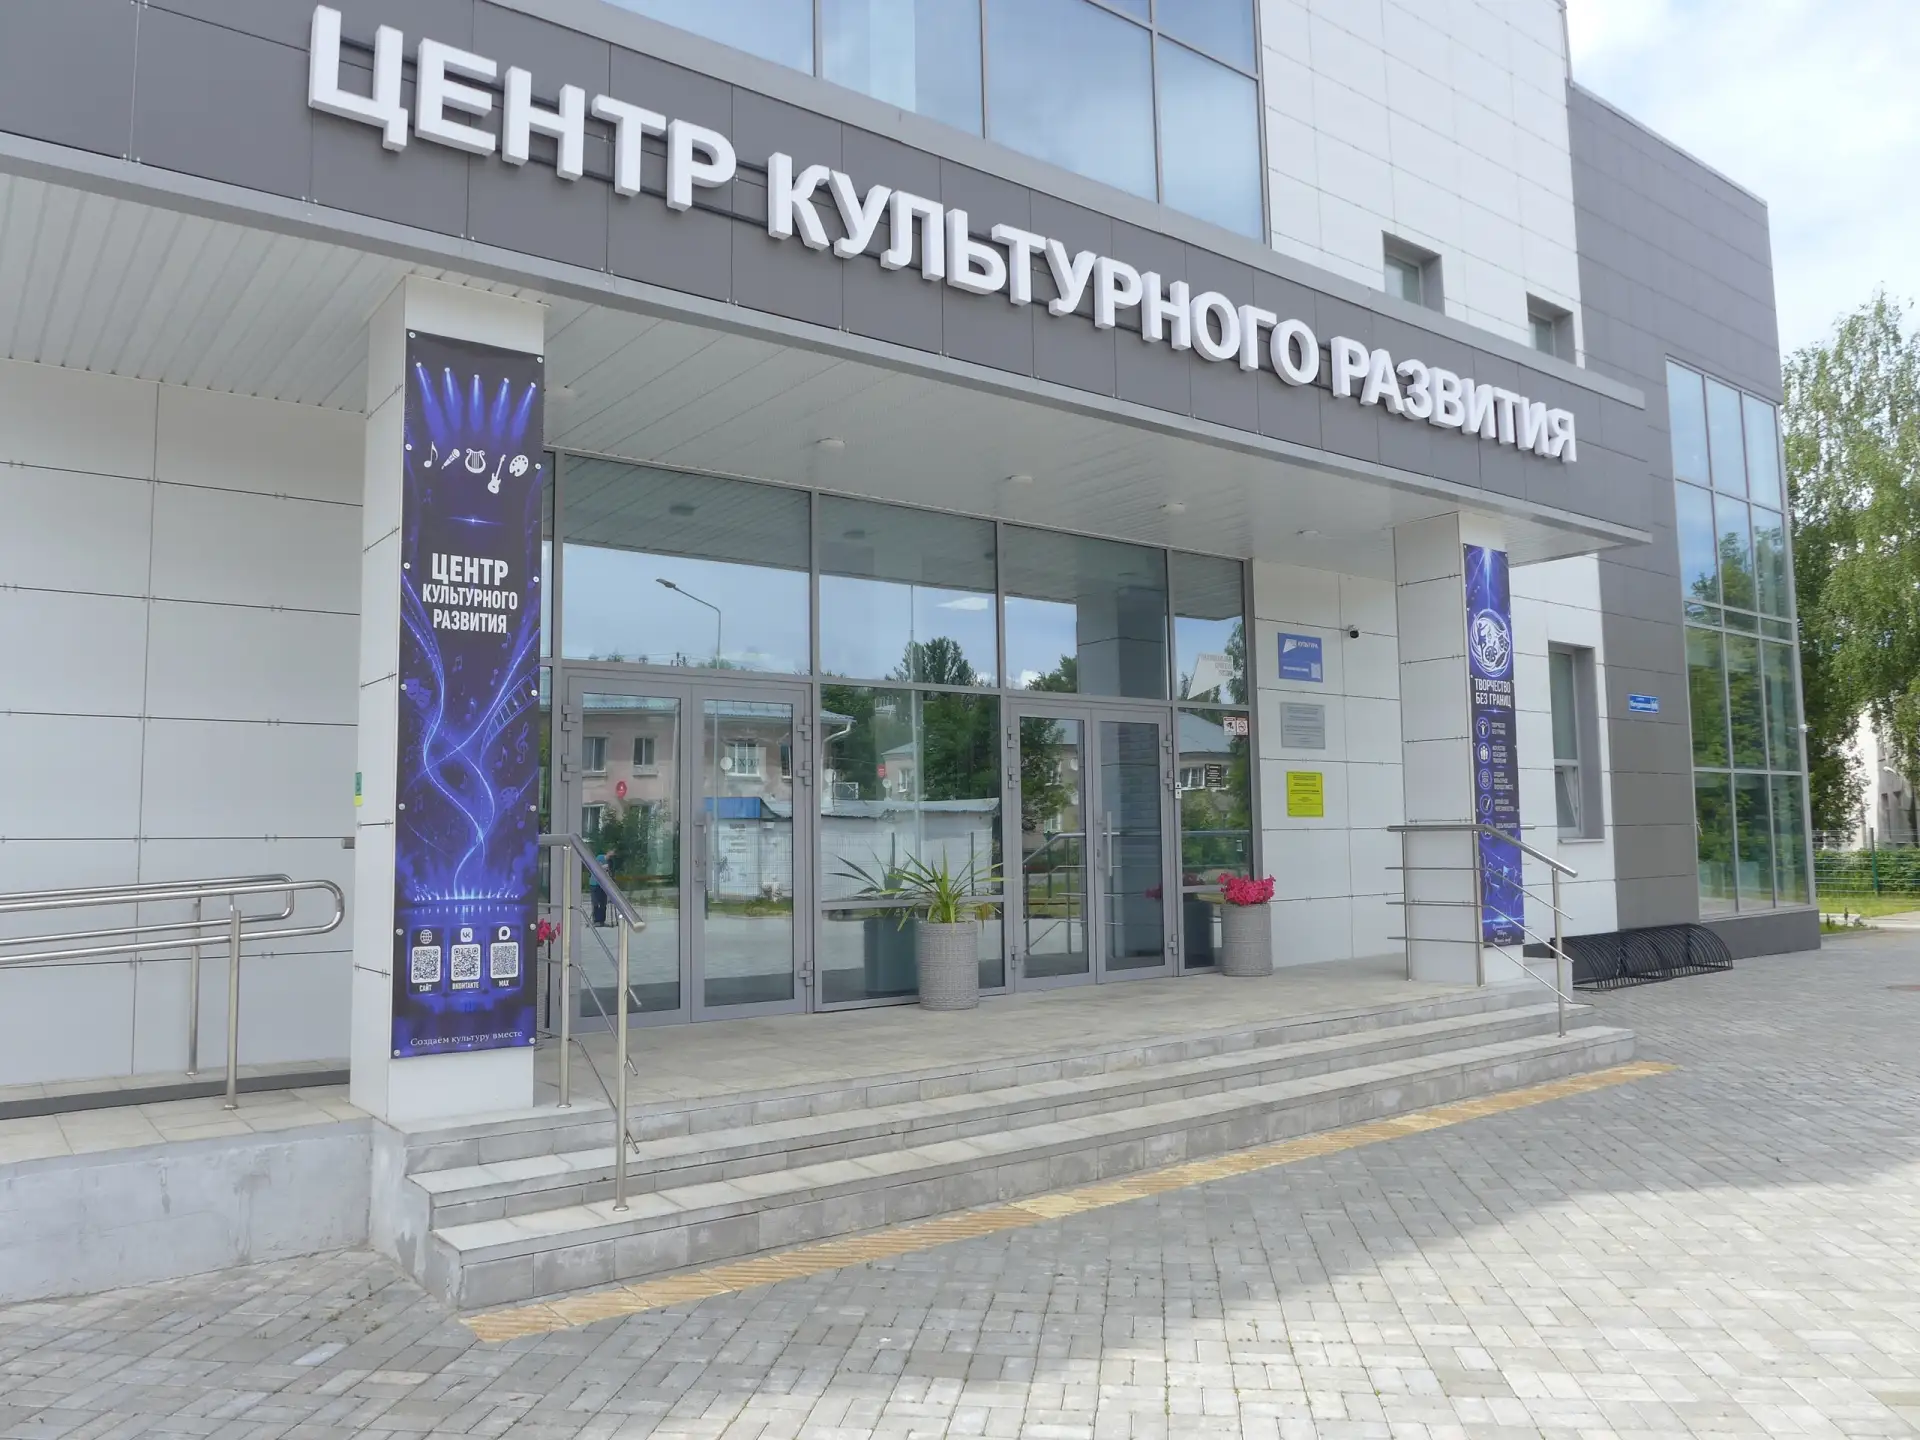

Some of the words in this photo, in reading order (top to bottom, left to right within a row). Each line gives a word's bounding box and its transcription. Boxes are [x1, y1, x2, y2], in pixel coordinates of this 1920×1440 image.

[308, 5, 737, 211] ЦЕНТР
[767, 152, 1320, 386] КУЛЬТУРНОГО
[1330, 335, 1577, 463] РАЗВИТИЯ
[432, 553, 509, 586] ЦЕНТР
[422, 583, 518, 610] КУЛЬТУРНОГО
[433, 609, 507, 634] РАЗВИТИЯ
[1475, 678, 1511, 693] ТВОРЧЕСТВО
[1475, 692, 1488, 705] БЕЗ
[1489, 693, 1512, 708] ГРАНИЦ
[419, 983, 433, 992] САЙТ
[452, 981, 480, 990] ВКОНТАКТЕ
[451, 1034, 490, 1045] культуру
[492, 1030, 523, 1039] вместе
